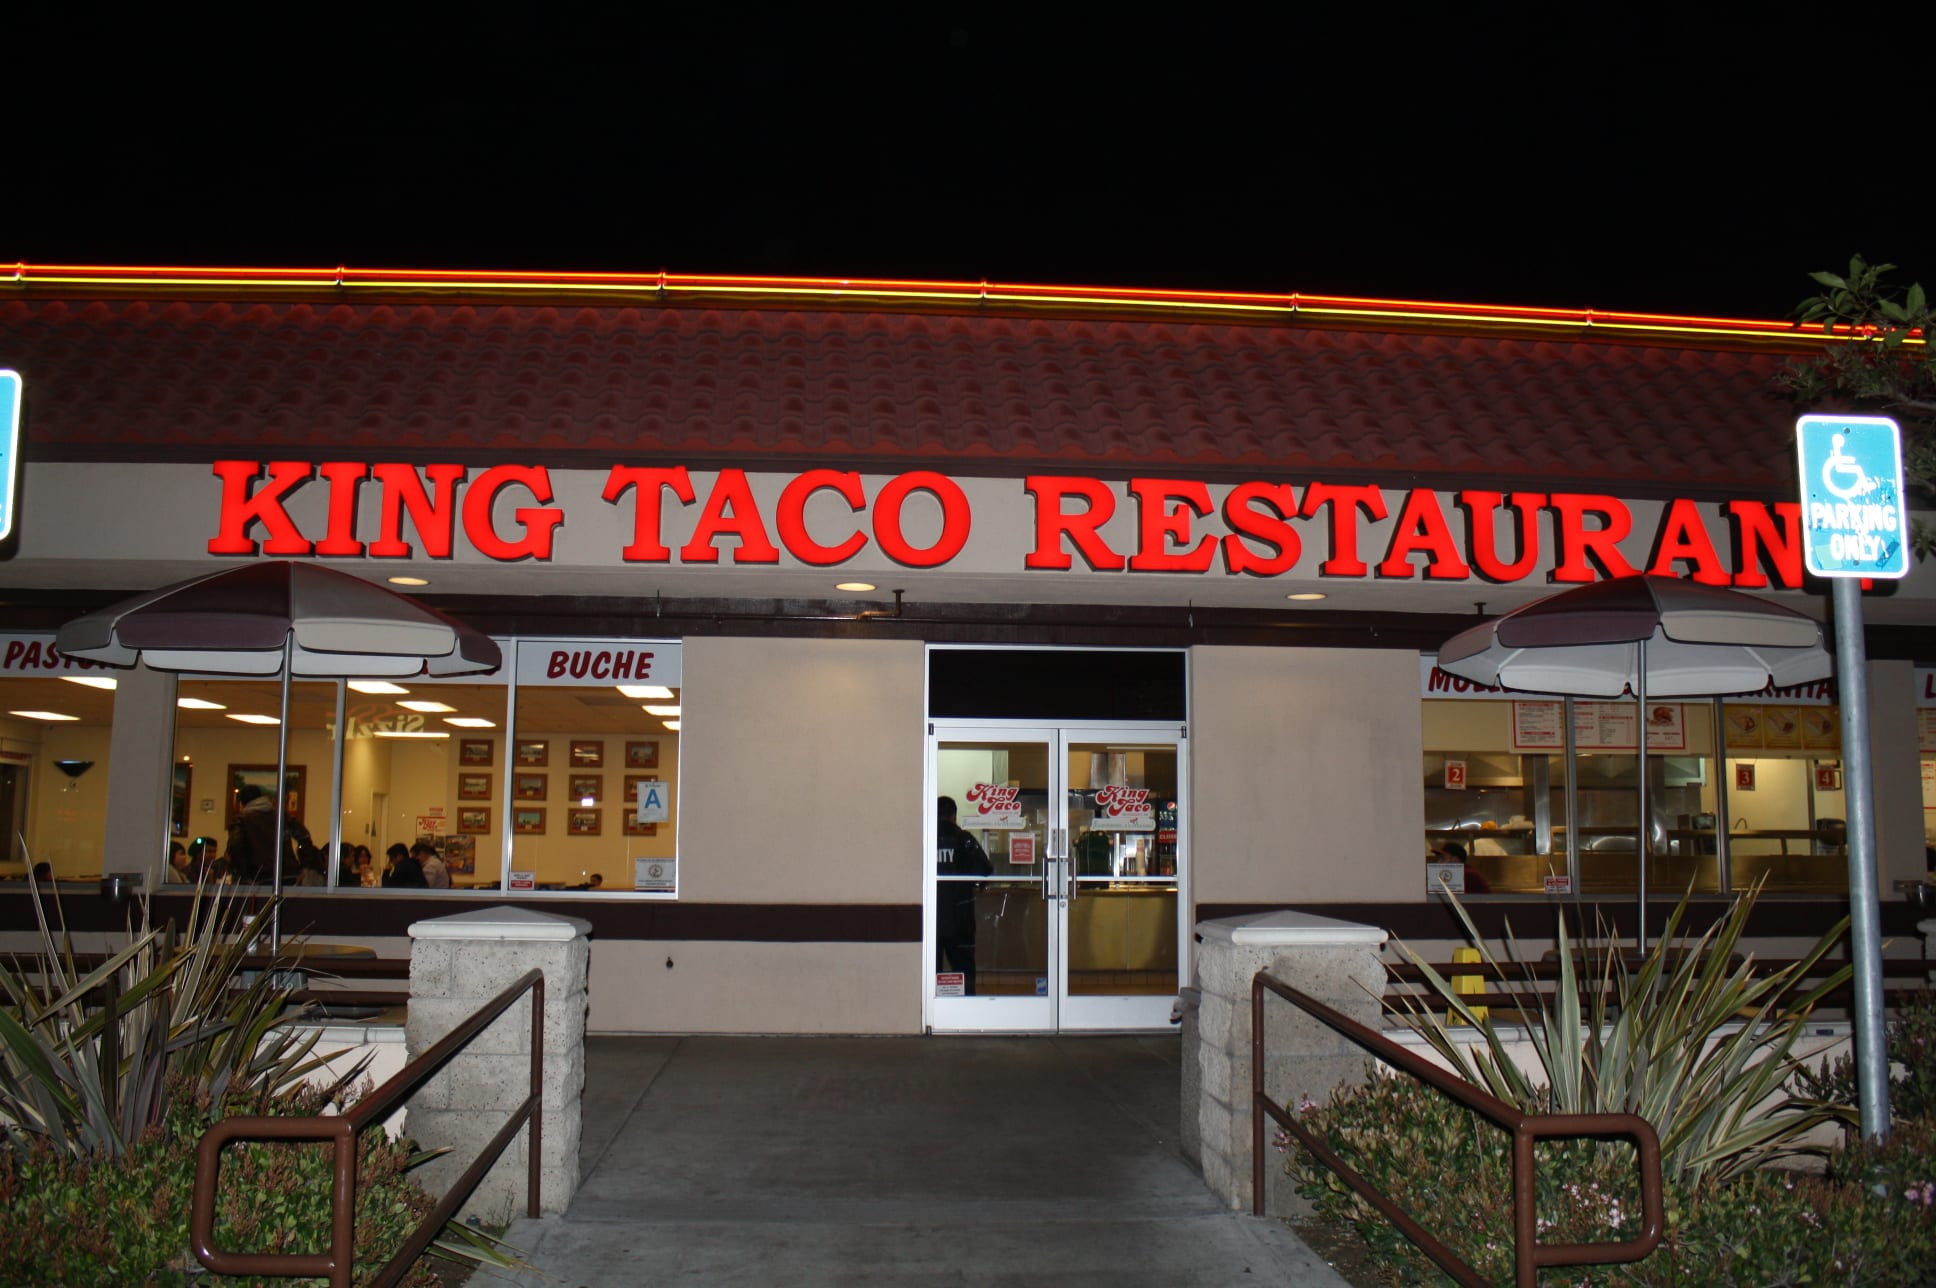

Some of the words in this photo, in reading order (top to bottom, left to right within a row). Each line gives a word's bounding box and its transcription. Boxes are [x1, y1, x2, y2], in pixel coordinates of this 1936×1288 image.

[207, 460, 564, 561] KING
[601, 464, 971, 567] TACO
[1024, 475, 1872, 589] RESTAURAN
[1810, 502, 1897, 531] PARKING
[1830, 533, 1881, 561] ONLY
[547, 651, 653, 679] BUCHE
[1452, 769, 1461, 781] 2
[1742, 772, 1750, 784] 3
[1822, 772, 1831, 784] 4
[644, 788, 661, 808] A
[966, 783, 1018, 802] King
[1096, 785, 1149, 803] King
[978, 797, 1020, 814] Taco
[1108, 799, 1151, 816] Taco
